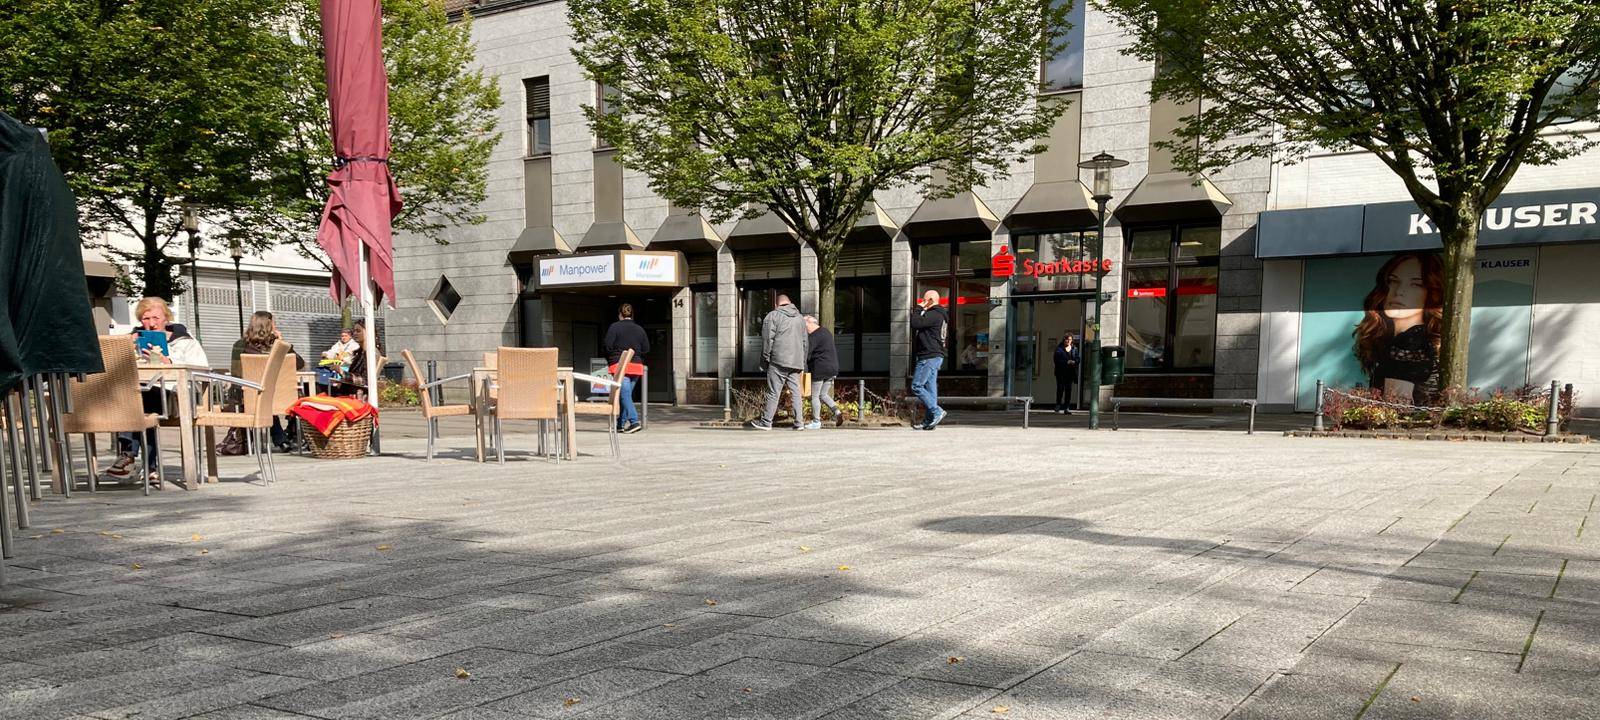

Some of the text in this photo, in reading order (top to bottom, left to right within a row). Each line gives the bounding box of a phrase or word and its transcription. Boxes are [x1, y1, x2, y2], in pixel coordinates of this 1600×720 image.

[1408, 202, 1598, 235] KUSER
[559, 263, 607, 277] Manpower
[1481, 259, 1530, 269] KLAUSER
[673, 298, 684, 308] 14
